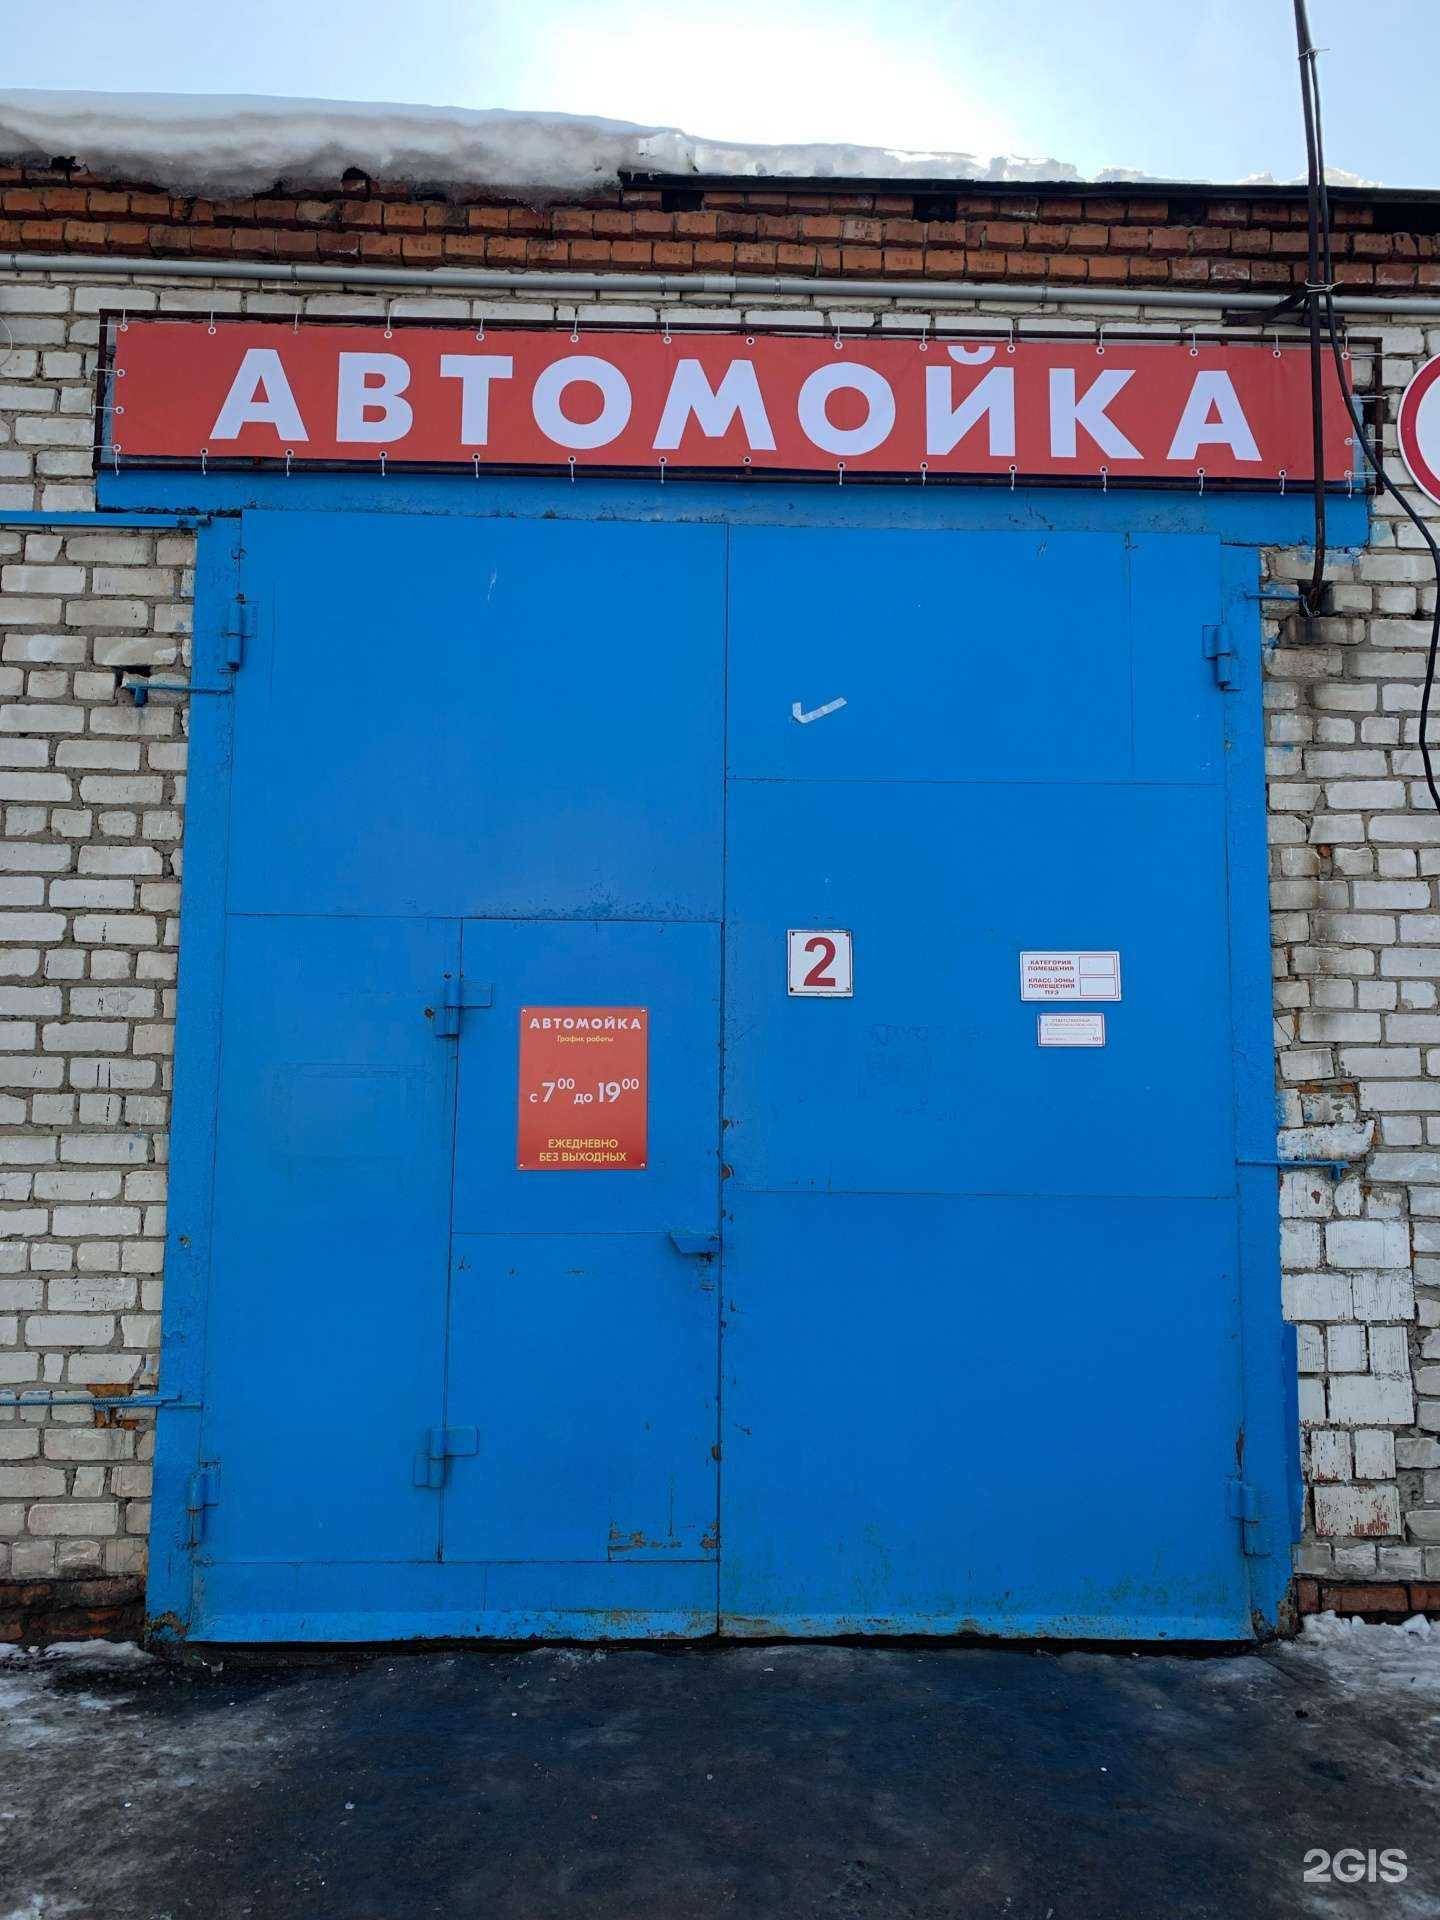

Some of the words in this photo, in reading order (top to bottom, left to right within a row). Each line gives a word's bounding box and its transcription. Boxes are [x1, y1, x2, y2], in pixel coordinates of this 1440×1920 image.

[208, 346, 1263, 461] АВТОМОЙКА
[804, 937, 836, 987] 2
[529, 1016, 642, 1030] АВТОМОЙКА
[557, 1035, 585, 1043] График
[586, 1035, 614, 1043] работы
[529, 1093, 538, 1103] с
[573, 1094, 594, 1105] до
[548, 1138, 618, 1149] ЕЖЕДНЕВНО
[539, 1152, 559, 1162] БЕЗ
[562, 1152, 627, 1164] ВЫХОДНЫХ
